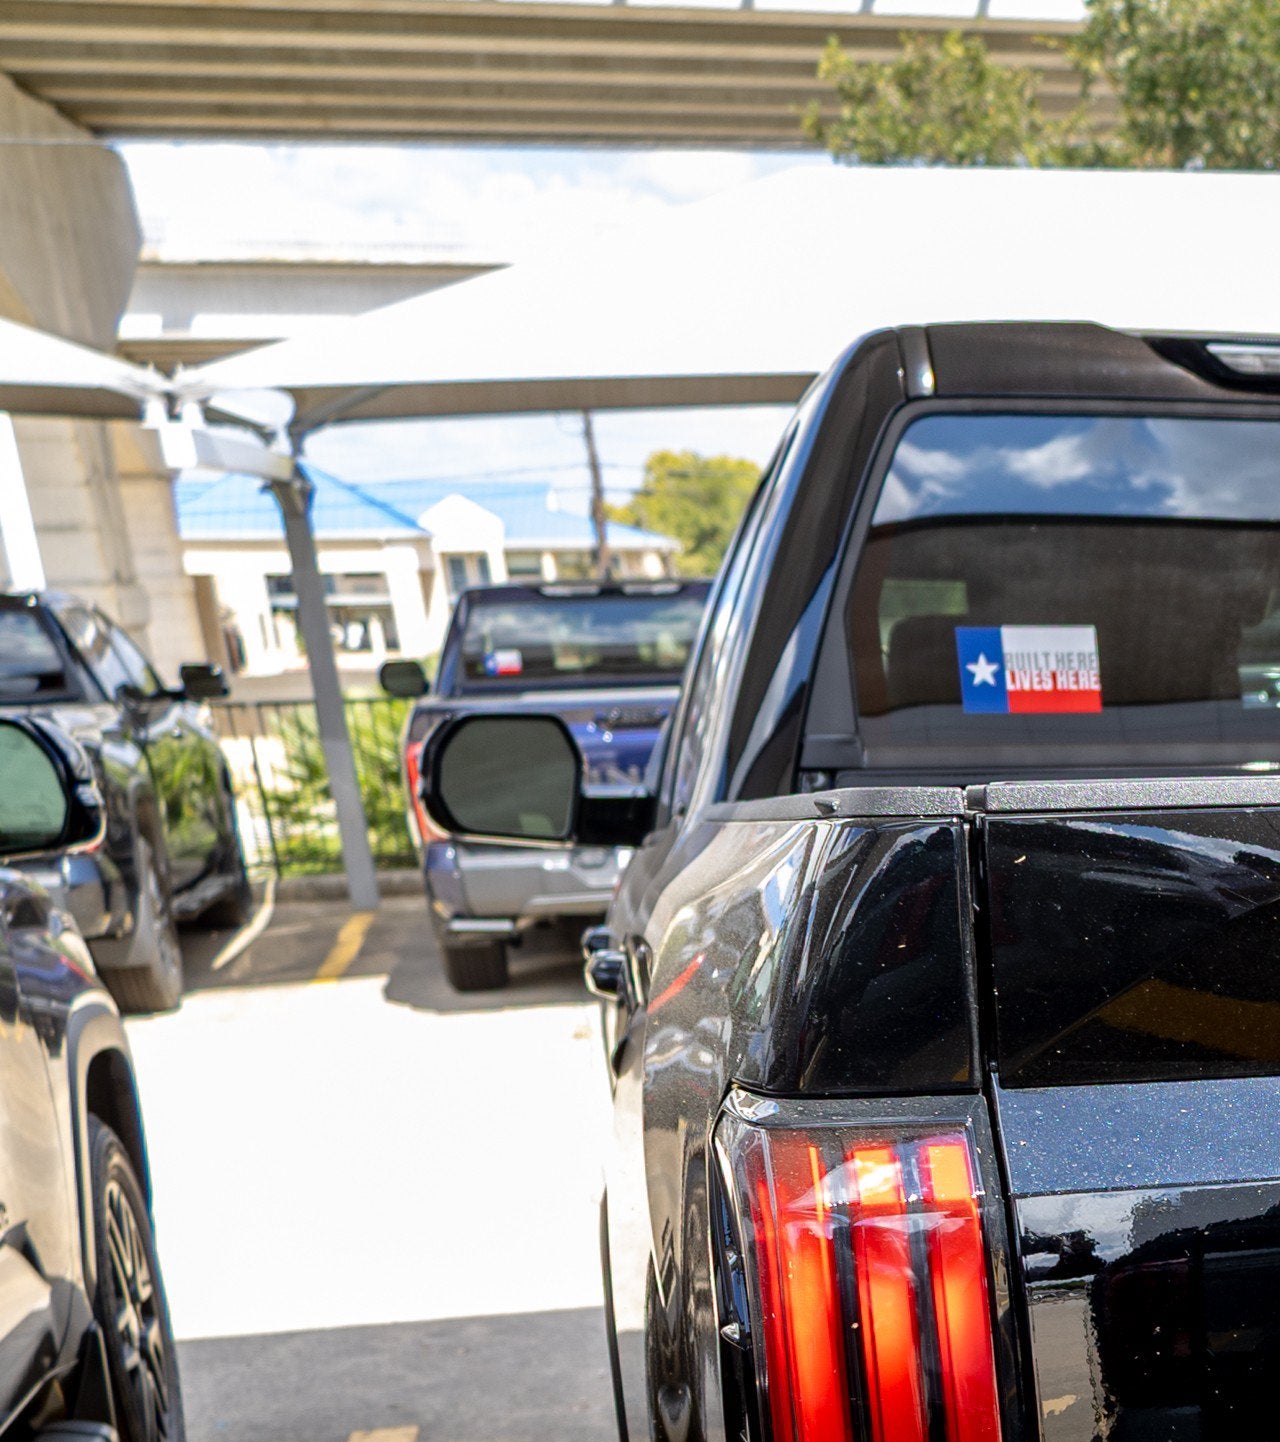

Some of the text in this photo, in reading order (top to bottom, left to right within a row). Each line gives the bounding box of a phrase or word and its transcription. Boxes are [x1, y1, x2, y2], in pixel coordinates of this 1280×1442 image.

[1005, 652, 1097, 671] BUILT HERE
[1005, 670, 1101, 691] LIVES HERE
